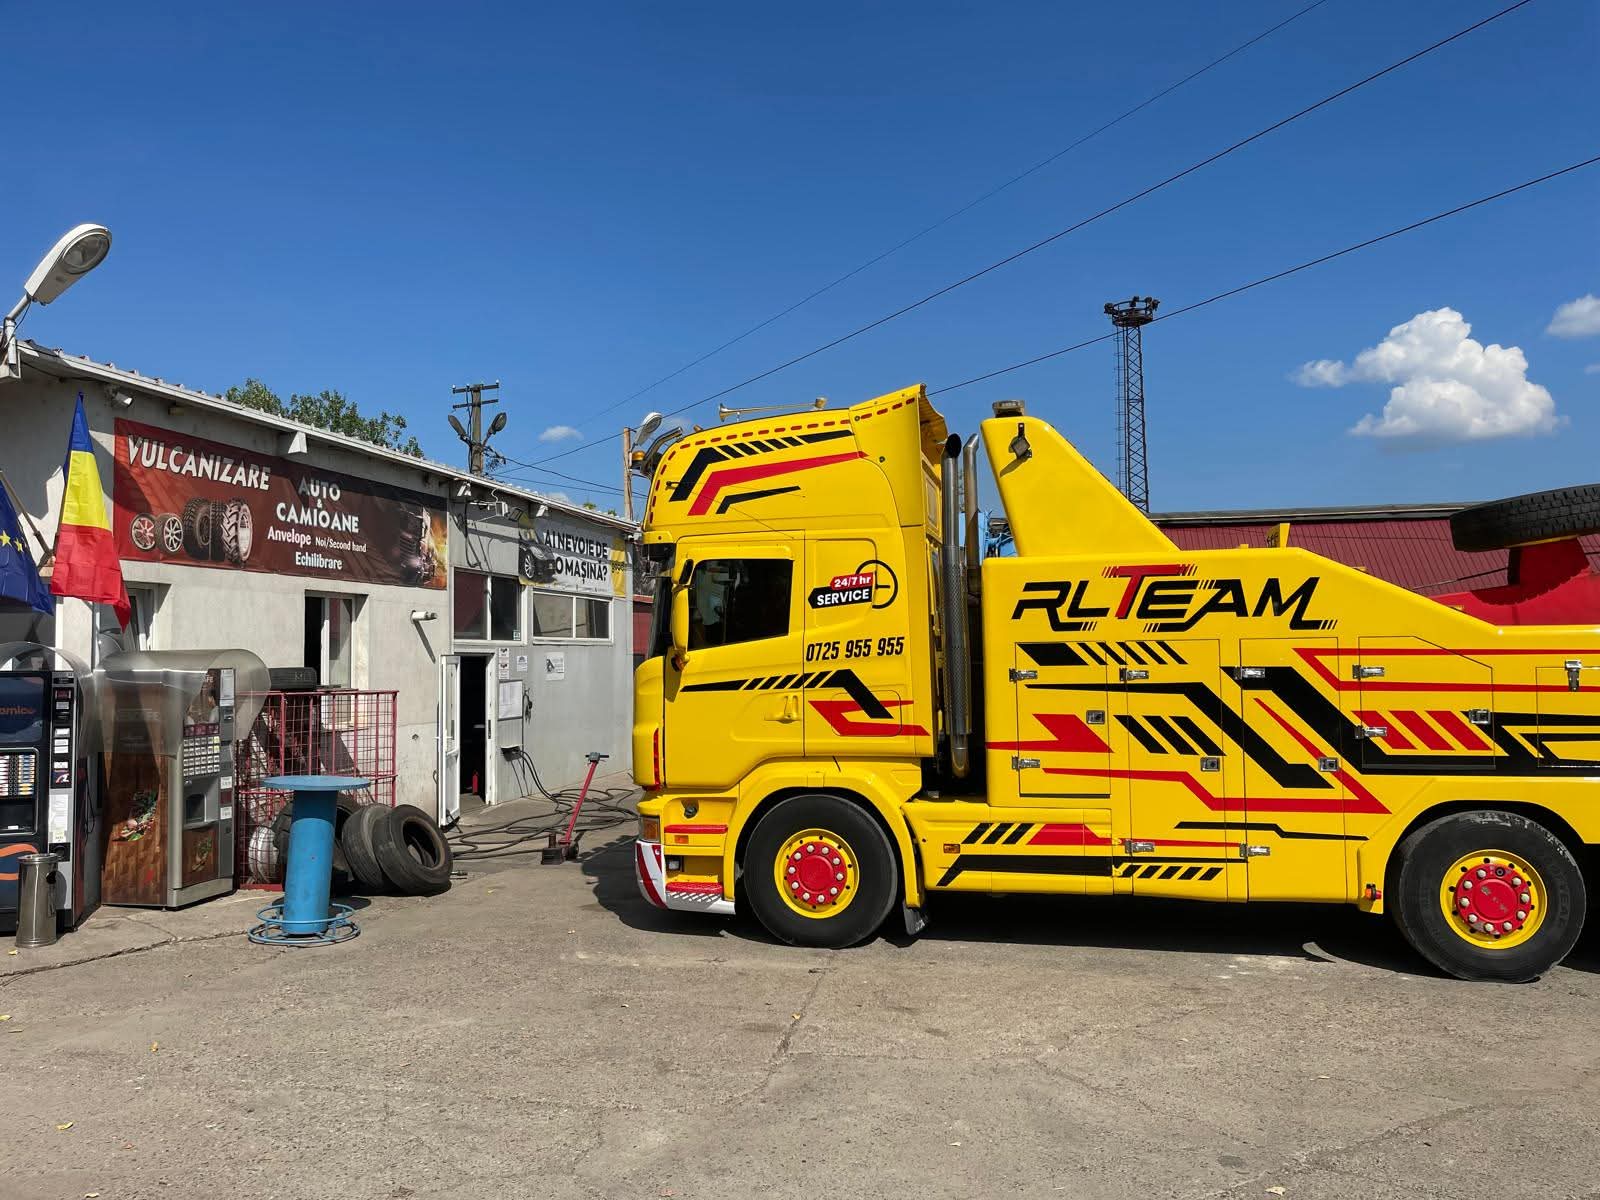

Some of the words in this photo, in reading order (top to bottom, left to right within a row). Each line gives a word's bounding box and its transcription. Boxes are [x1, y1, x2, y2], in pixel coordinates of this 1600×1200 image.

[128, 435, 271, 491] VULCANIZARE
[298, 475, 341, 501] AUTO
[316, 499, 322, 508] &
[276, 502, 359, 533] CAMIOANE
[267, 526, 312, 548] Anvelope
[315, 536, 351, 551] Noi/Second
[352, 541, 367, 553] hand
[557, 531, 595, 557] NEVOIE
[295, 551, 343, 570] Echilibrare
[834, 576, 857, 588] 24/7
[859, 575, 872, 584] hr
[816, 588, 870, 606] SERVICE
[806, 641, 840, 662] 0725
[844, 639, 872, 659] 955
[877, 636, 905, 656] 955
